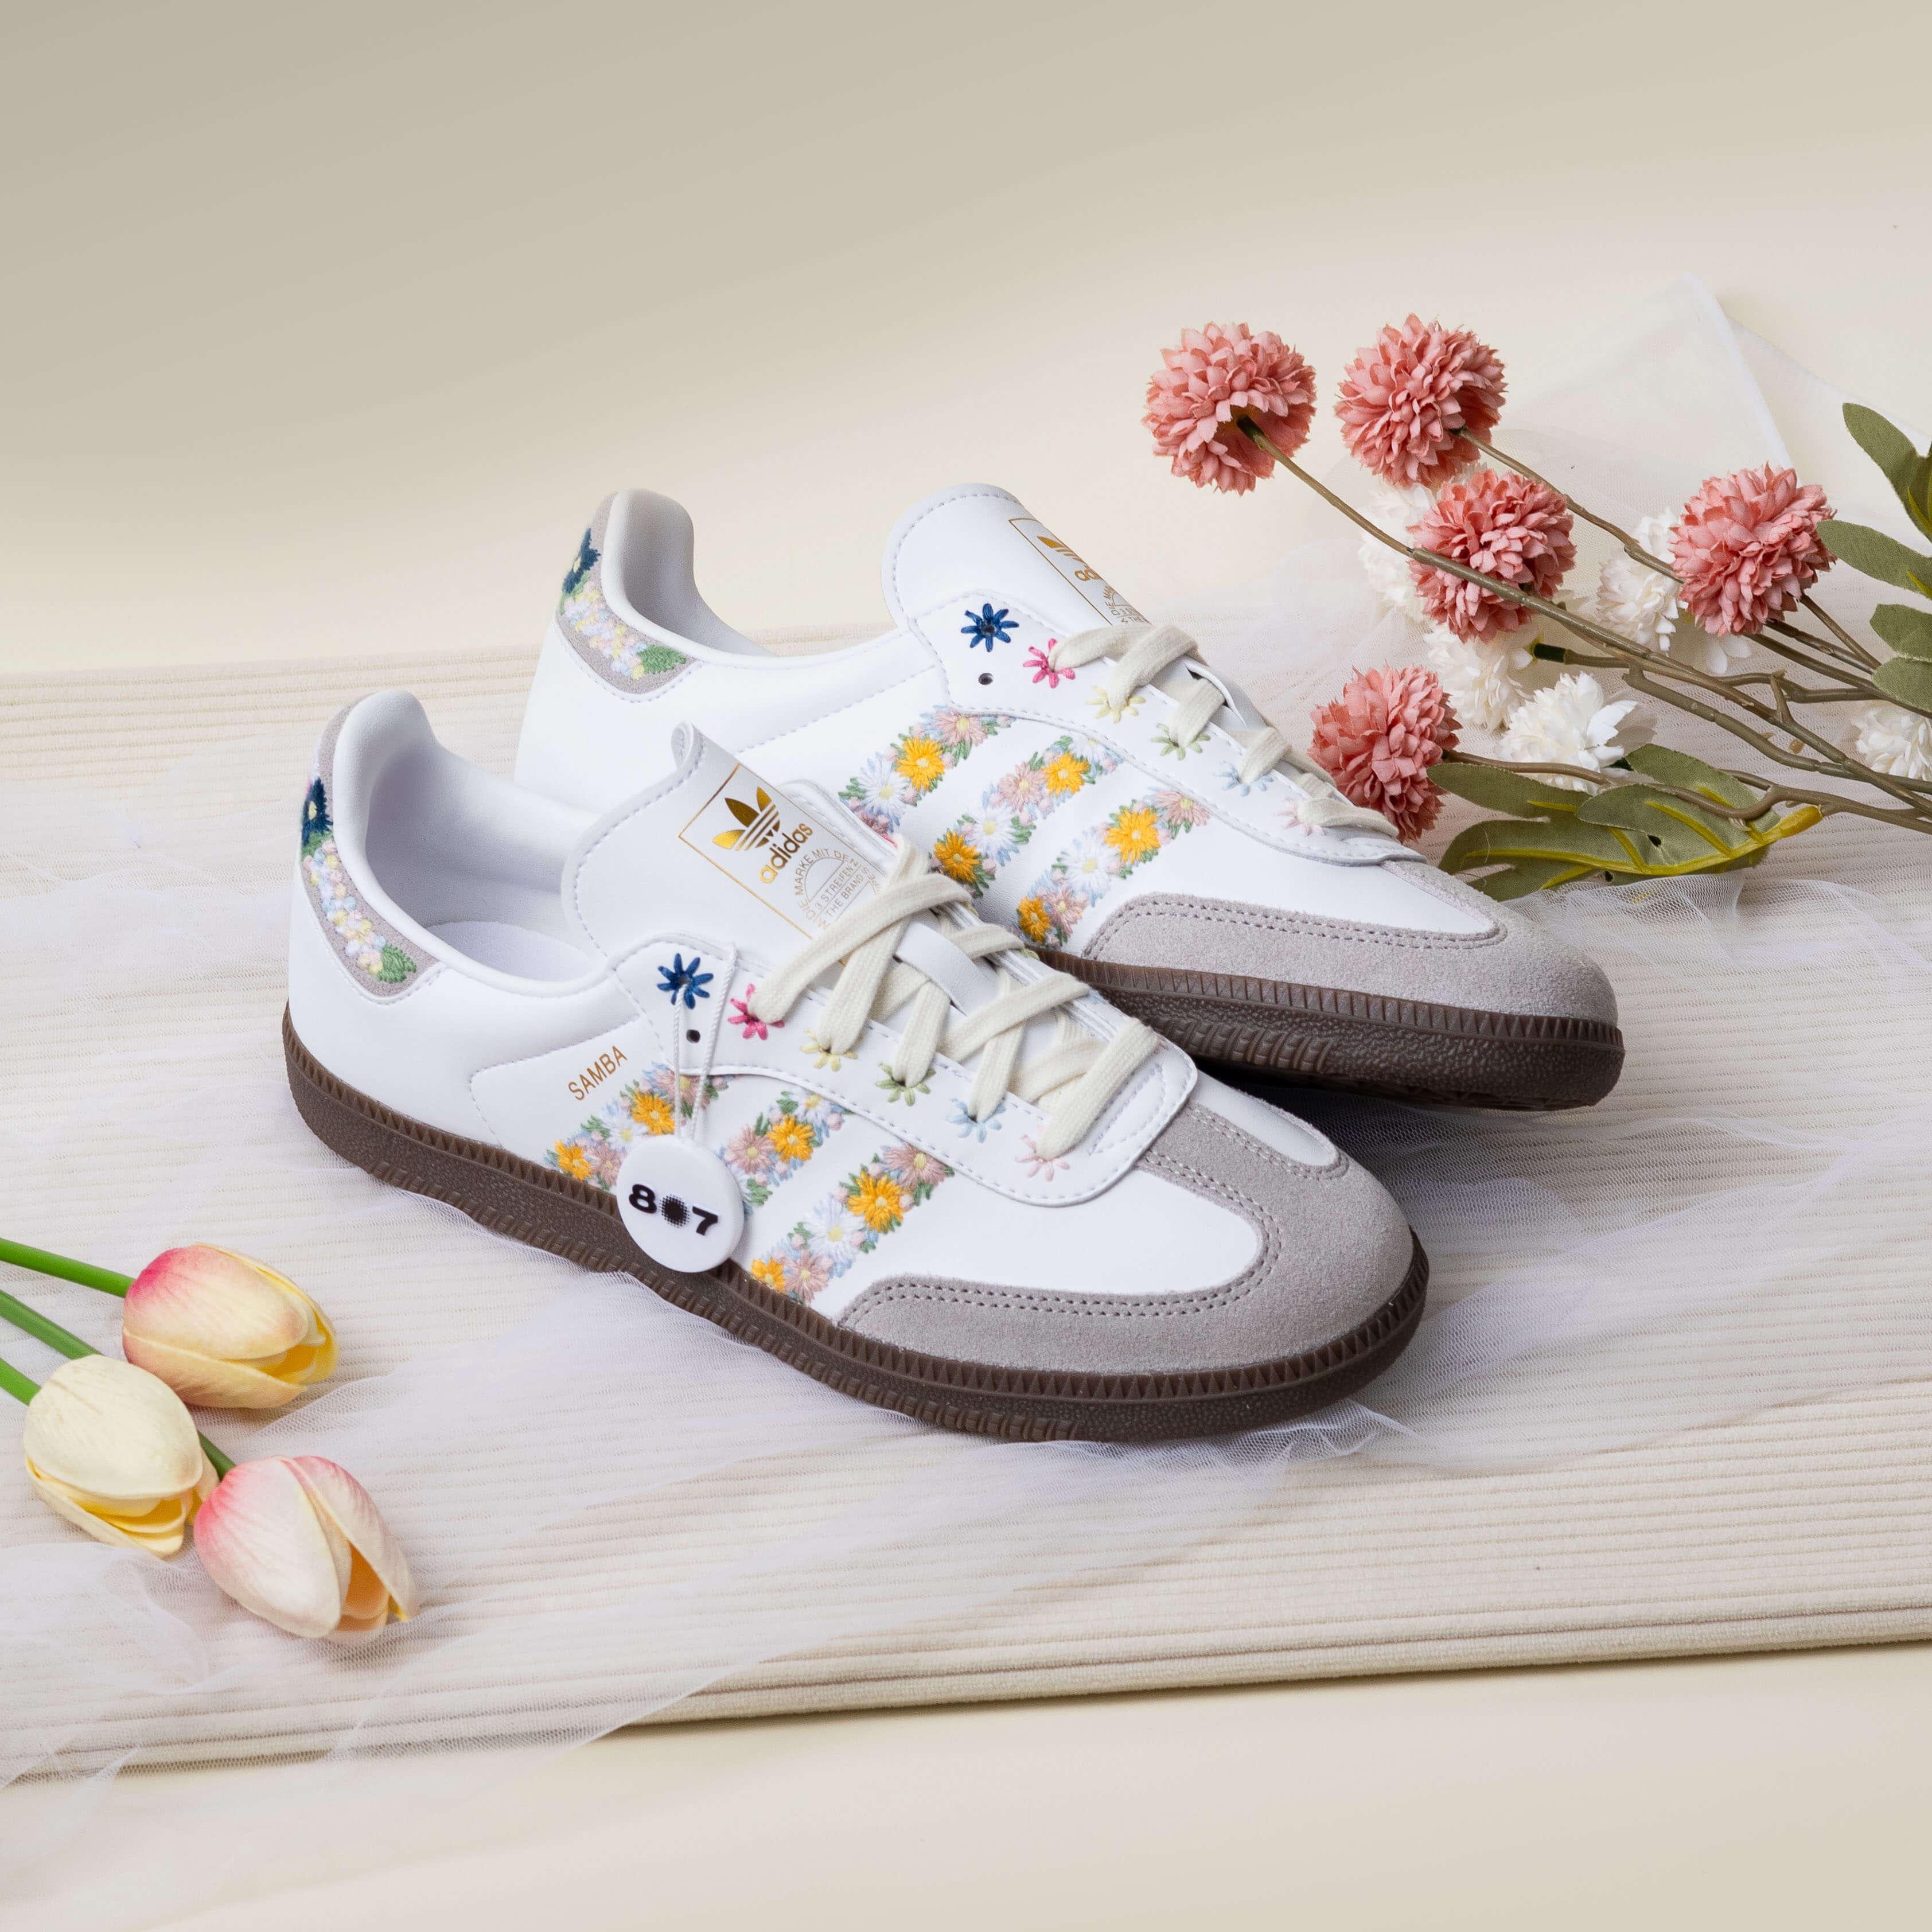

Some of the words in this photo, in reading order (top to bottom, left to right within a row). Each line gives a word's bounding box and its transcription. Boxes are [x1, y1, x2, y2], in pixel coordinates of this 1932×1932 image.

[759, 823, 813, 883] adidas
[794, 854, 813, 895] MARKE
[812, 848, 829, 859] MIT
[820, 865, 854, 903] STREIFEN
[826, 898, 843, 916] THE
[841, 874, 864, 899] BRAND
[568, 1045, 628, 1101] SAMBA
